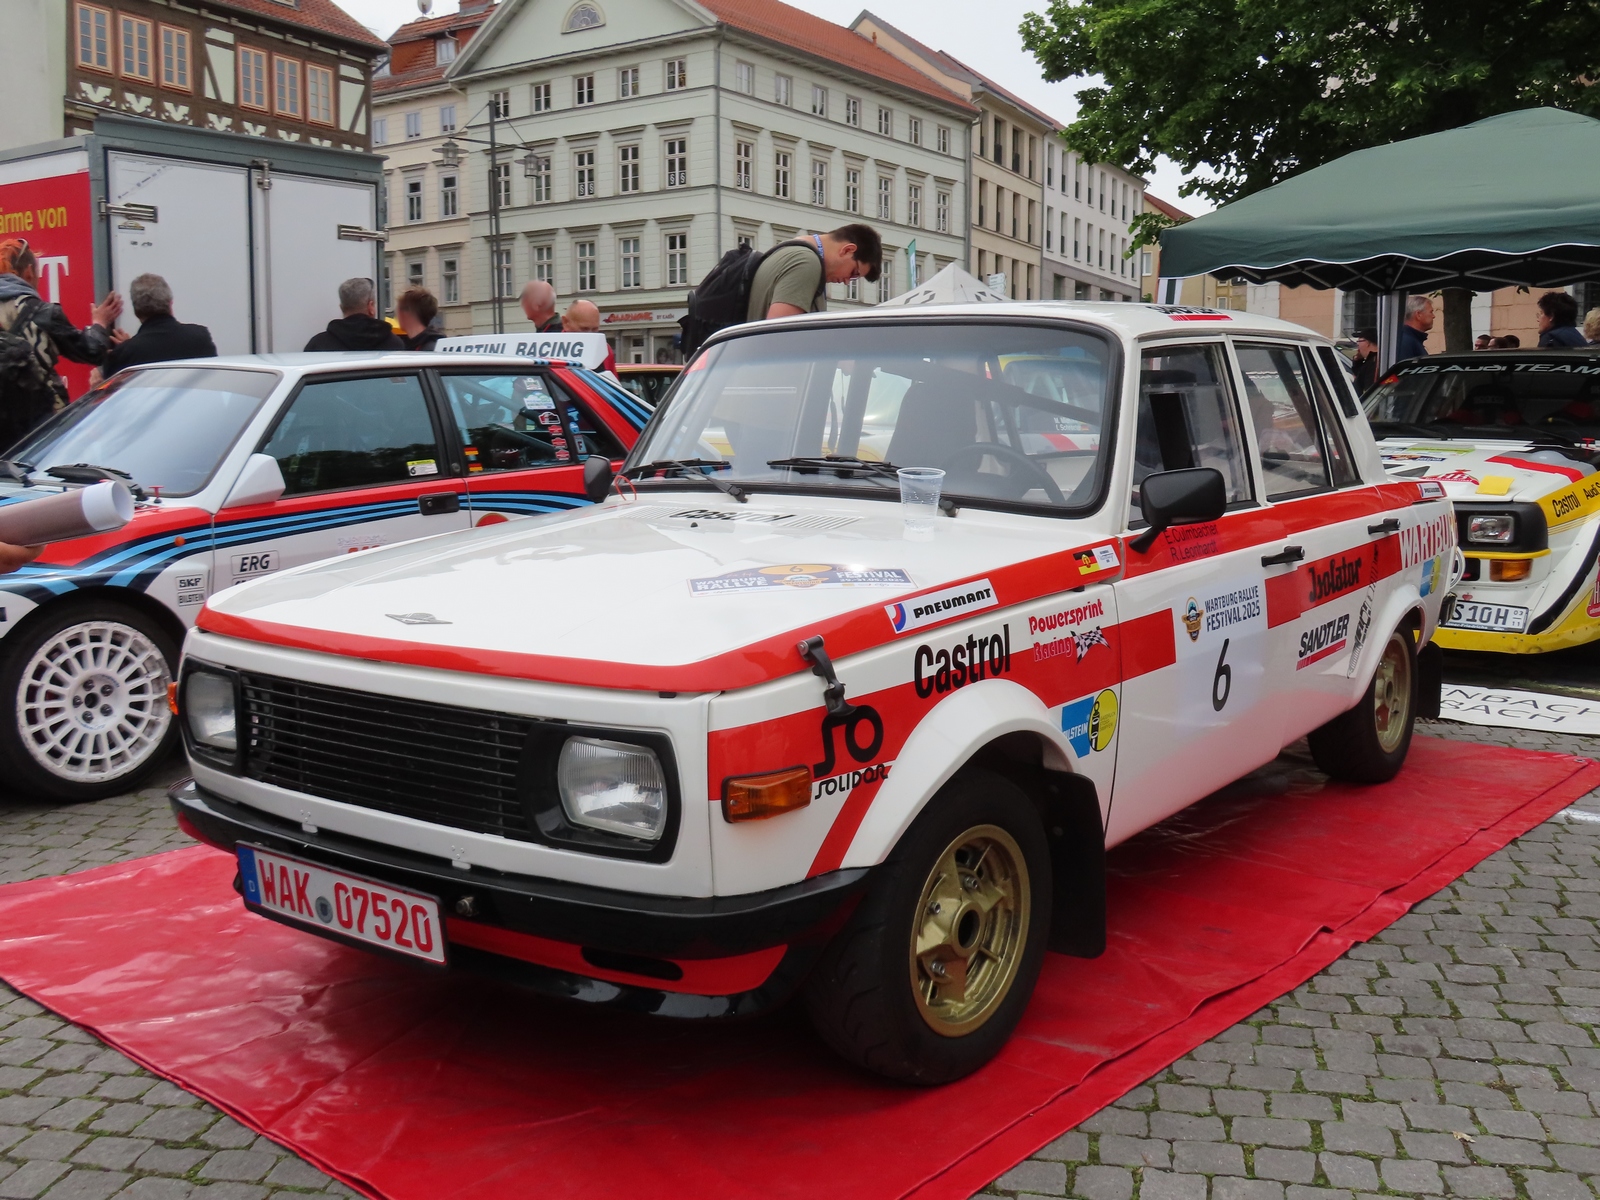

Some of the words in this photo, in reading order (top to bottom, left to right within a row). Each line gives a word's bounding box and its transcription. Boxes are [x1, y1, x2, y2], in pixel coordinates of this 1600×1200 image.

[37, 206, 67, 229] von
[515, 341, 584, 357] RACING
[1400, 365, 1440, 375] HB
[1440, 364, 1507, 373] Audi
[1514, 363, 1600, 375] TEAM
[1552, 492, 1581, 518] Castrol
[1583, 484, 1598, 500] Audi
[1165, 524, 1219, 545] E.Culmbacher
[240, 554, 270, 572] ERG
[1171, 541, 1218, 562] R.Leonhardt
[179, 578, 202, 588] SKF
[698, 580, 769, 591] RALLYE
[837, 571, 902, 579] FESTIVAL
[913, 588, 992, 618] PNEUMANT
[1205, 592, 1239, 613] WARTBURG
[1239, 586, 1259, 601] RALLYE
[1028, 598, 1104, 635] Powersprint
[1206, 609, 1243, 632] FESTIVAL
[1242, 600, 1261, 620] 2025
[1033, 637, 1075, 662] Racing
[1299, 613, 1350, 659] SANDTLER
[914, 624, 1011, 698] Castrol
[1212, 638, 1231, 711] 6
[1442, 687, 1600, 715] NBACH
[815, 763, 888, 800] SOLIDOR
[258, 858, 314, 918] WAK
[334, 882, 433, 954] 07520
